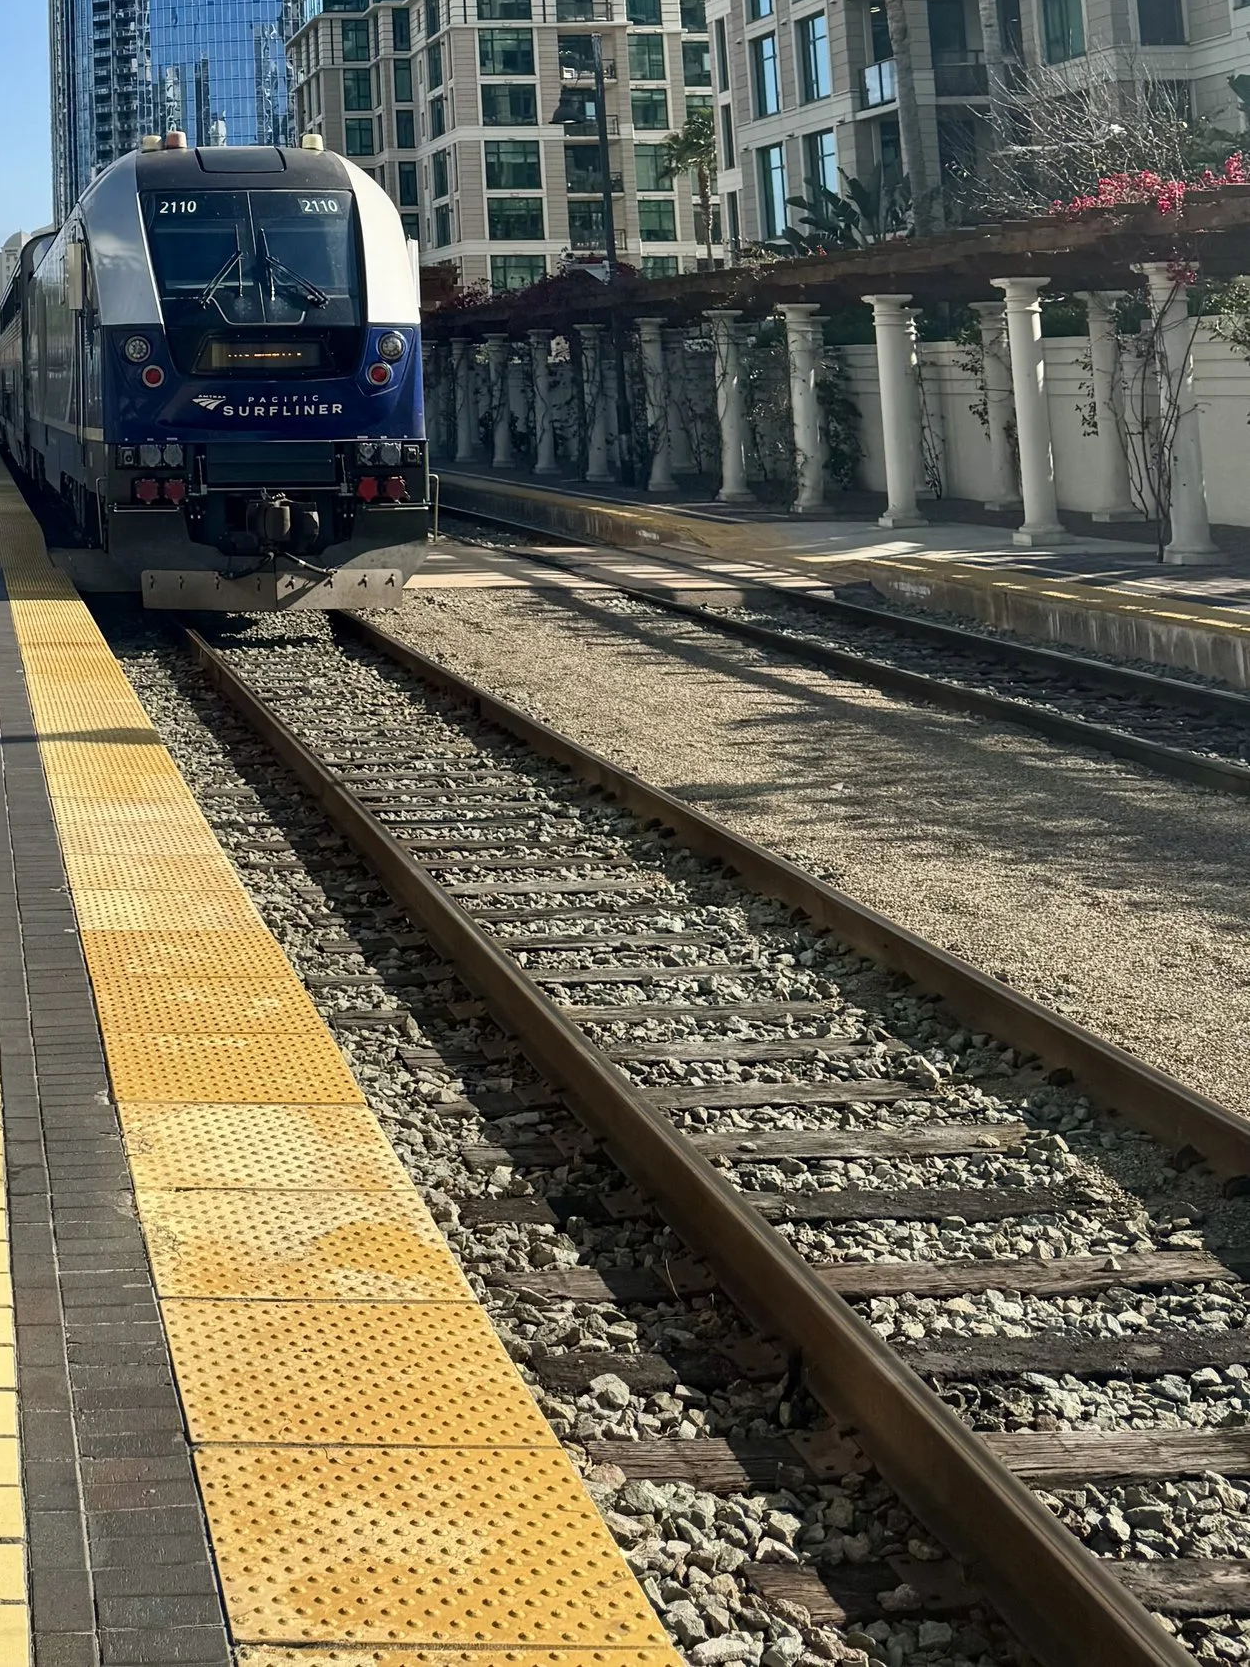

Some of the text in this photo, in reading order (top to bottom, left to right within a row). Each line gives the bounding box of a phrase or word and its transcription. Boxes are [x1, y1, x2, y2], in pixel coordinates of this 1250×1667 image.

[159, 200, 197, 214] 2110
[301, 199, 338, 213] 2110
[248, 394, 319, 403] PACIFIC
[222, 403, 343, 417] SURFLINER
